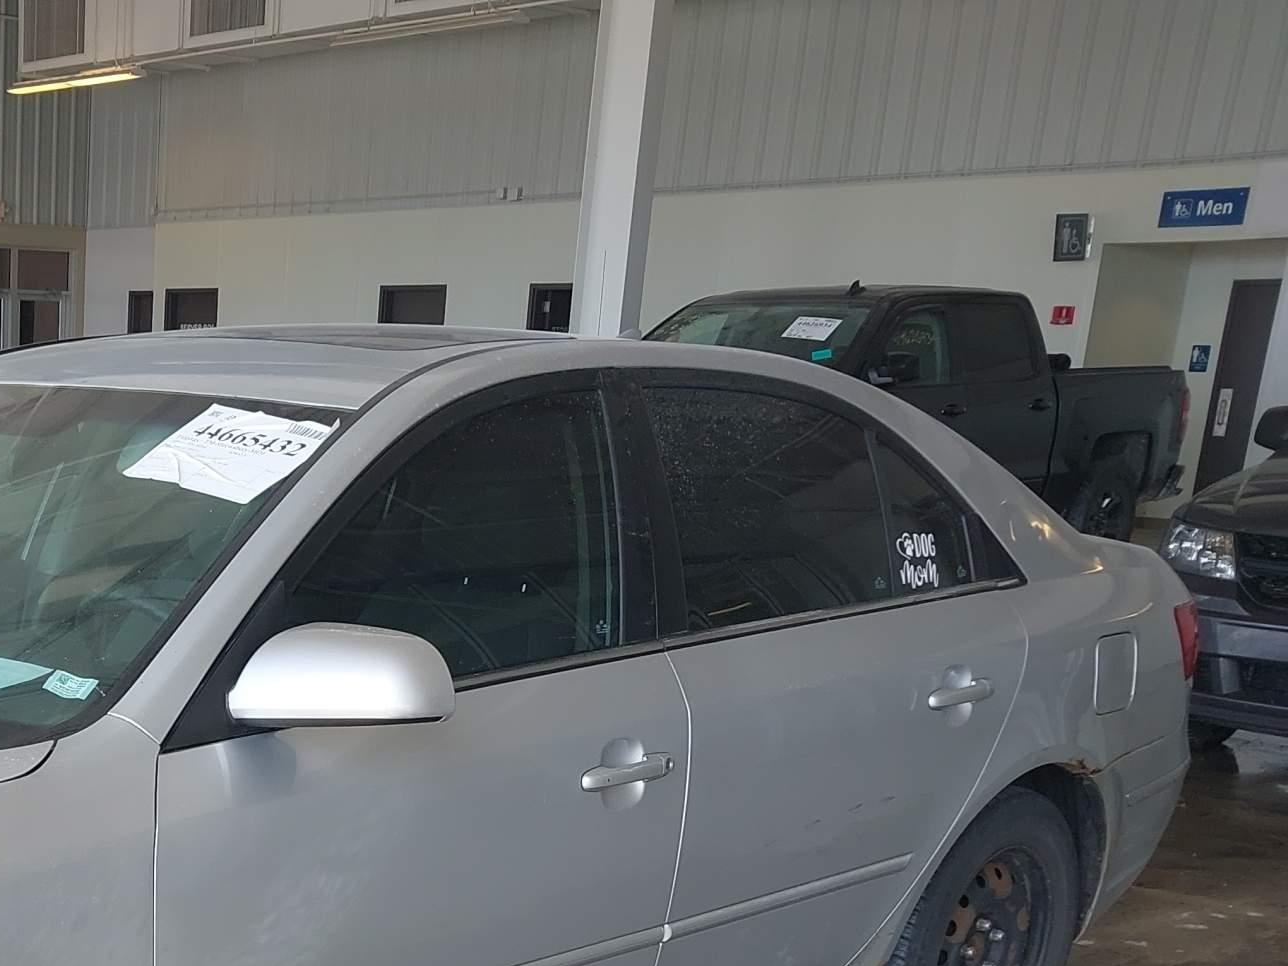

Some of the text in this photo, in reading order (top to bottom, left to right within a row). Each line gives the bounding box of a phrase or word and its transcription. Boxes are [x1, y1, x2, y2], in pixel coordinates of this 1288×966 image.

[1196, 200, 1233, 217] Men
[193, 423, 307, 457] 44665432
[913, 533, 936, 557] DOG
